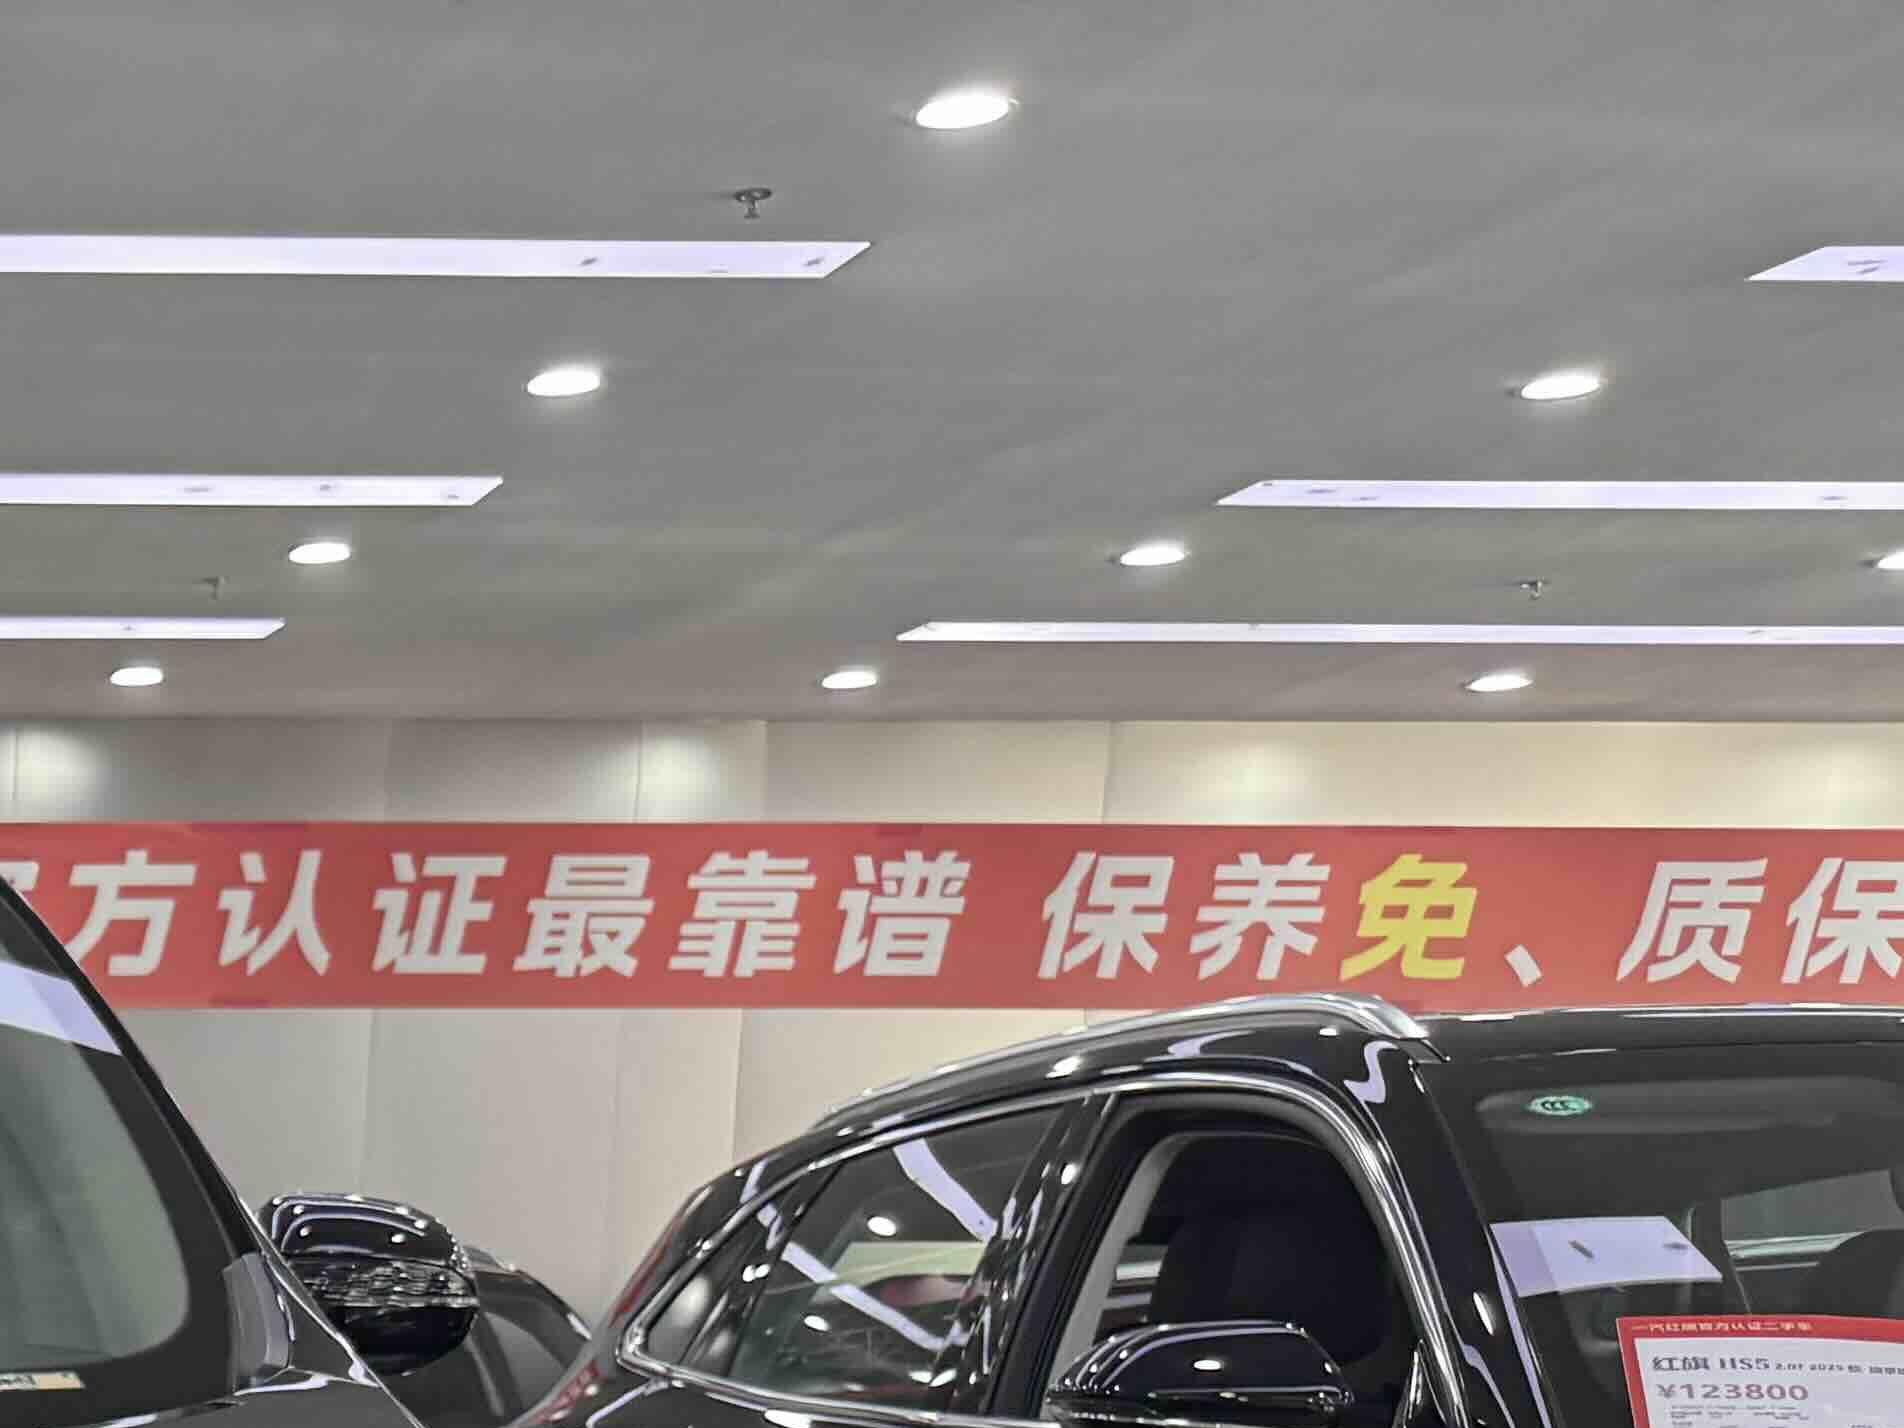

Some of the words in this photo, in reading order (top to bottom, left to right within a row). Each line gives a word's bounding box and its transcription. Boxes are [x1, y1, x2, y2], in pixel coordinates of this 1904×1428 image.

[1652, 1355, 1710, 1372] 红旗
[1719, 1357, 1770, 1371] HS5
[1658, 1384, 1809, 1400] ¥123800
